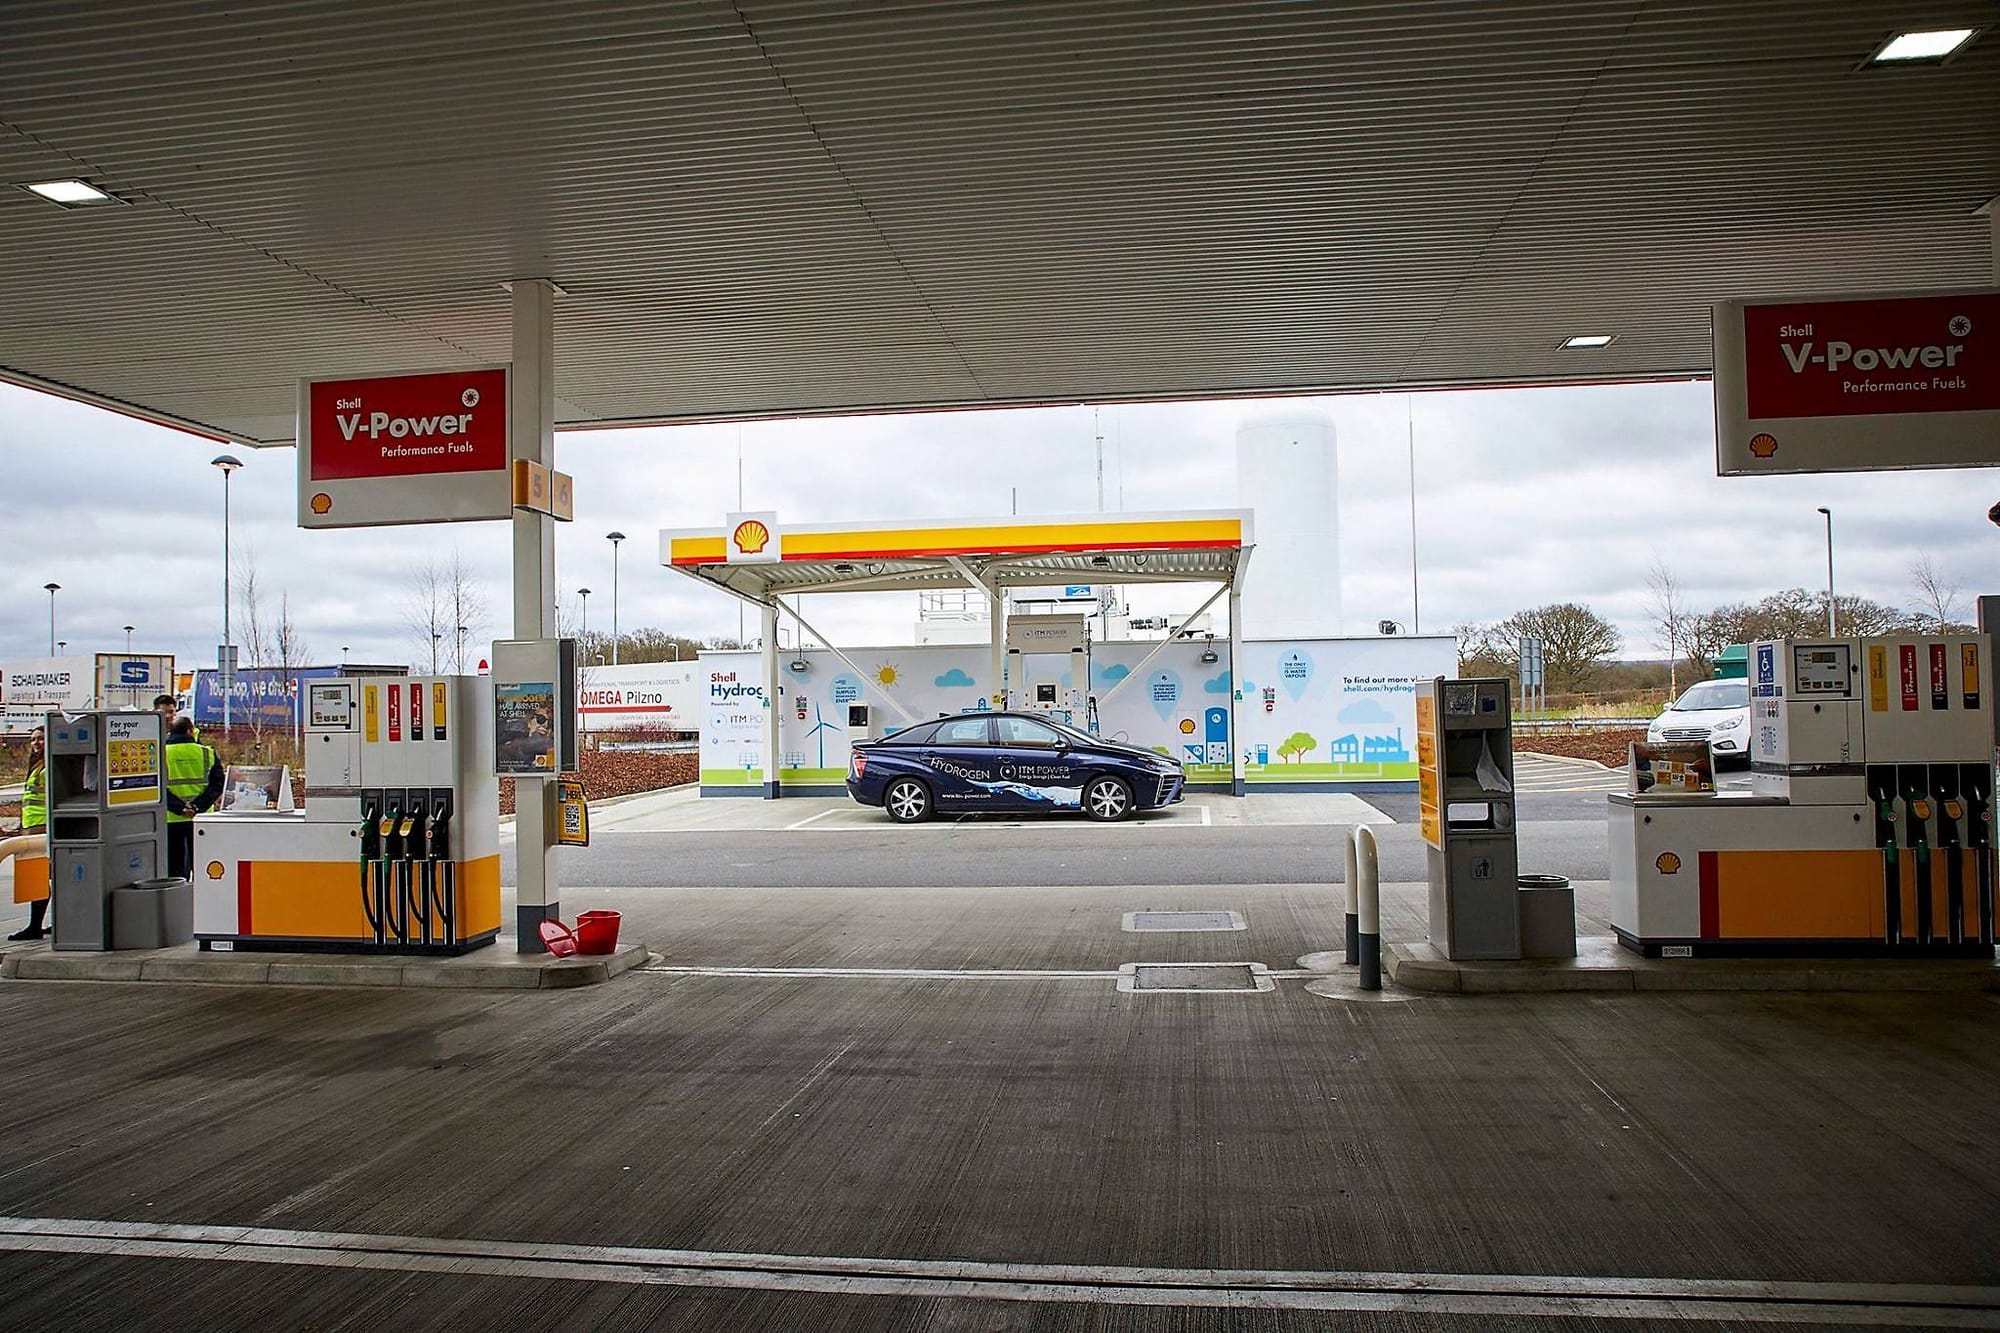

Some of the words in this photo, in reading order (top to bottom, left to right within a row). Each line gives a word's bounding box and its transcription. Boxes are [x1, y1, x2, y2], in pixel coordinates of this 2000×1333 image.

[1780, 324, 1813, 337] Shell
[1781, 341, 1963, 373] V-Power
[1843, 379, 1928, 393] Performance
[1932, 376, 1967, 389] Fuels
[336, 398, 361, 410] Shell
[336, 411, 473, 441] V-Power
[381, 444, 445, 458] Performance
[448, 441, 474, 453] Fuels
[533, 473, 542, 498] 5
[559, 484, 569, 506] 6
[11, 672, 71, 687] SCHAVEMAKER
[711, 672, 736, 682] Shell
[1354, 676, 1370, 684] find
[711, 683, 784, 700] Hydrogn
[1344, 685, 1415, 694] shell.com/hydrog
[580, 690, 622, 705] OMEGA
[627, 691, 662, 704] Pilzno
[110, 720, 122, 728] For
[123, 721, 139, 729] your
[730, 715, 747, 723] ITM
[110, 730, 131, 738] safety
[930, 758, 990, 779] HYDROGEN
[1018, 766, 1034, 774] ITM
[1037, 766, 1069, 774] POWER
